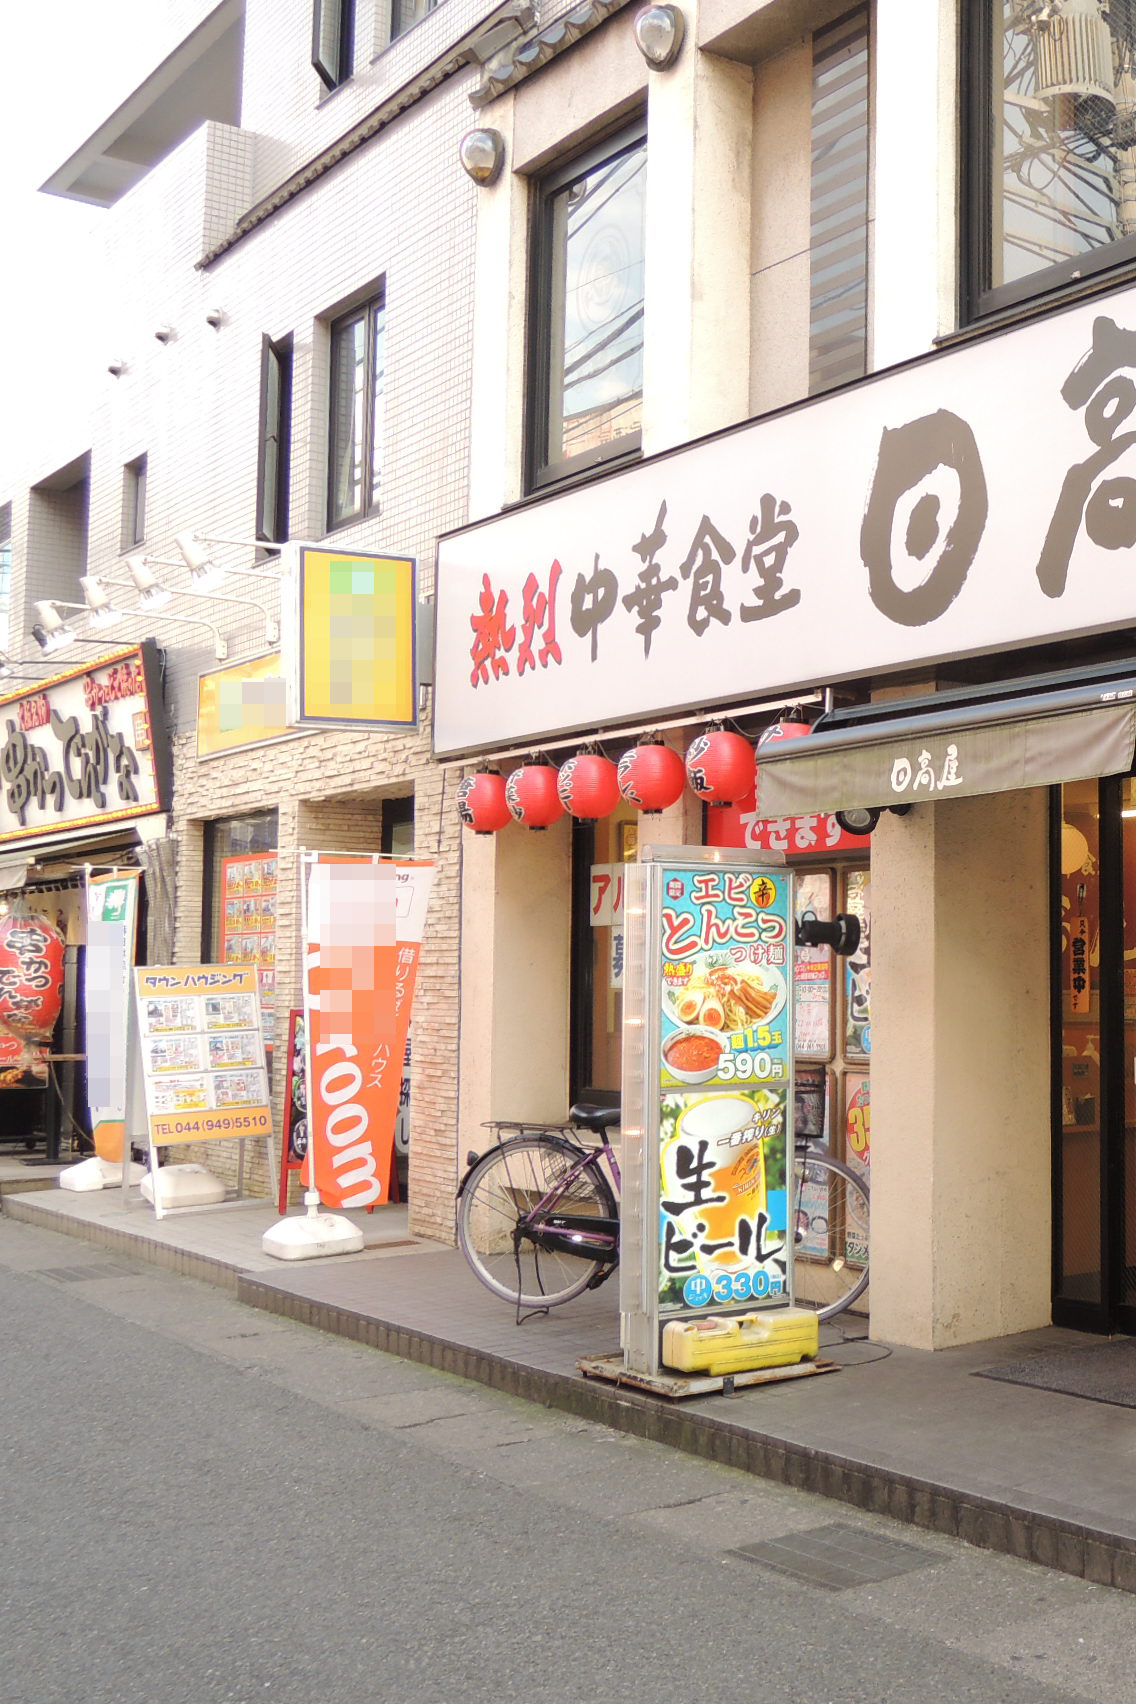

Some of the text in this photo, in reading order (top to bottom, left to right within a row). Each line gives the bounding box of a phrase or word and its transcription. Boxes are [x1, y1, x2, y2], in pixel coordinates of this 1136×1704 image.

[890, 744, 963, 792] 日高屋
[740, 812, 842, 849] できます
[691, 873, 773, 905] エビ 辛
[662, 904, 787, 960] とんこつ
[5, 928, 53, 990] 串かつ
[730, 943, 786, 966] つけ麺
[1072, 937, 1087, 994] 営業中
[145, 972, 249, 990] タウンハウジング
[717, 1052, 784, 1081] 590円
[154, 1115, 267, 1136] TEL 044(949)5510
[752, 1108, 781, 1124] キリン
[661, 1140, 727, 1216] 生
[664, 1212, 786, 1273] ビール
[690, 1278, 706, 1295] 中
[713, 1269, 783, 1302] 330円
